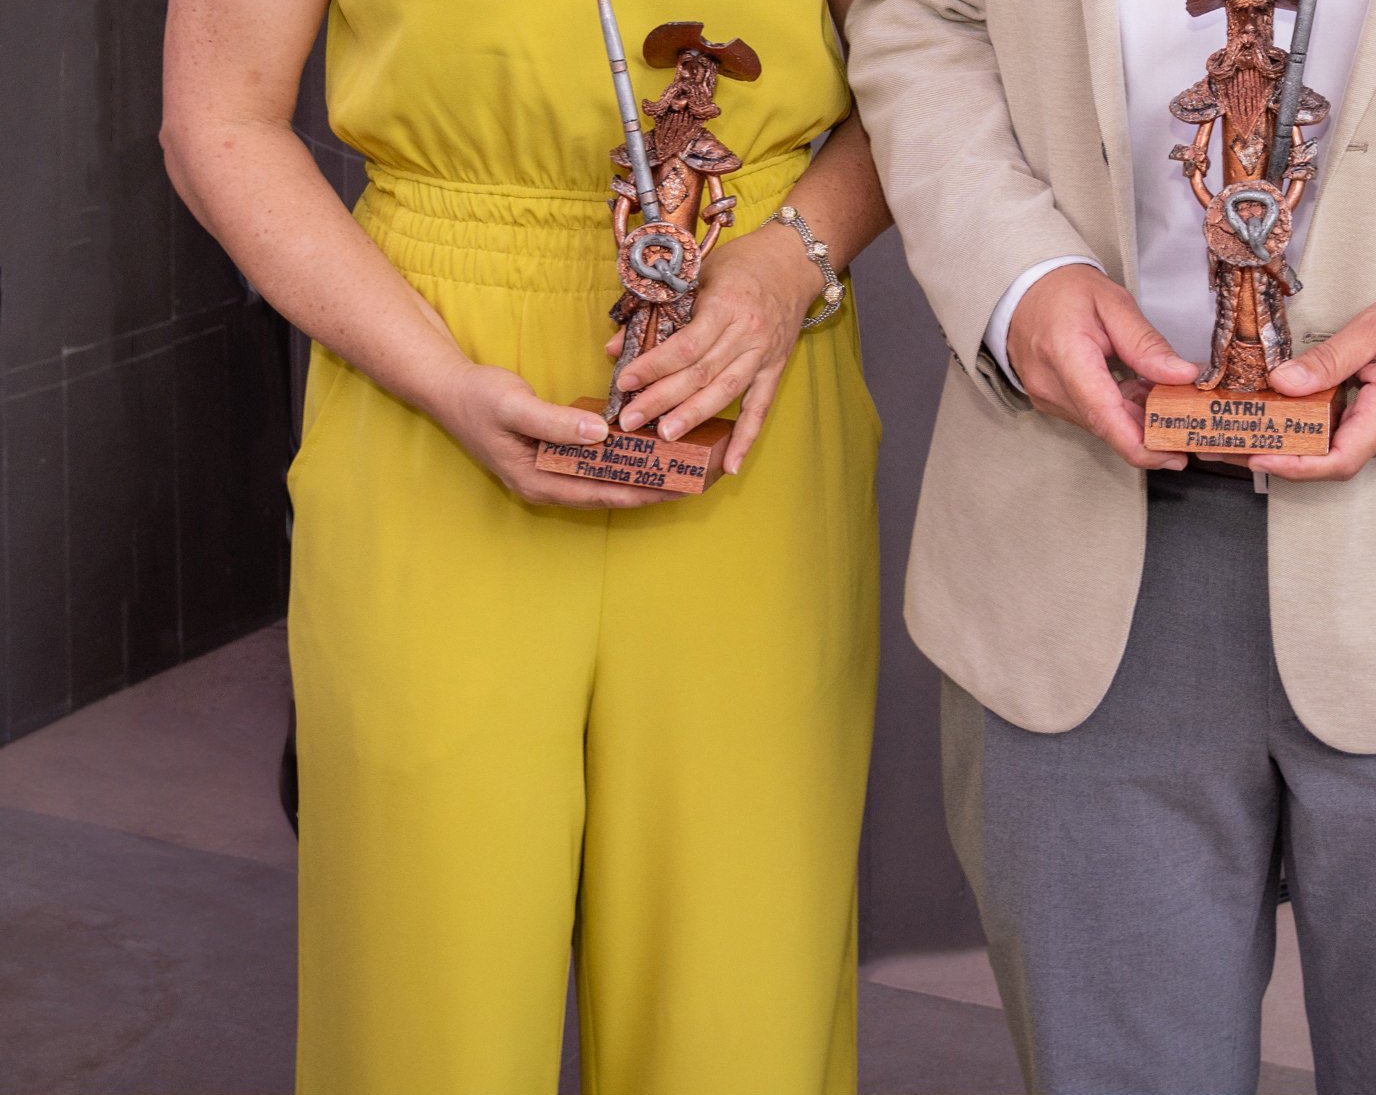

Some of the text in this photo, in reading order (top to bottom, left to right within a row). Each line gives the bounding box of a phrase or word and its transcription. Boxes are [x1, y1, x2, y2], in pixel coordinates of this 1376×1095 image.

[1210, 400, 1265, 416] OATRH
[1149, 413, 1324, 434] Premios Manuel A. Pérez
[603, 435, 655, 454] OATRH
[1186, 432, 1283, 449] Finalista 2025
[545, 444, 705, 477] Premios Manuel A. Pérez
[576, 462, 666, 487] Finalista 2025
